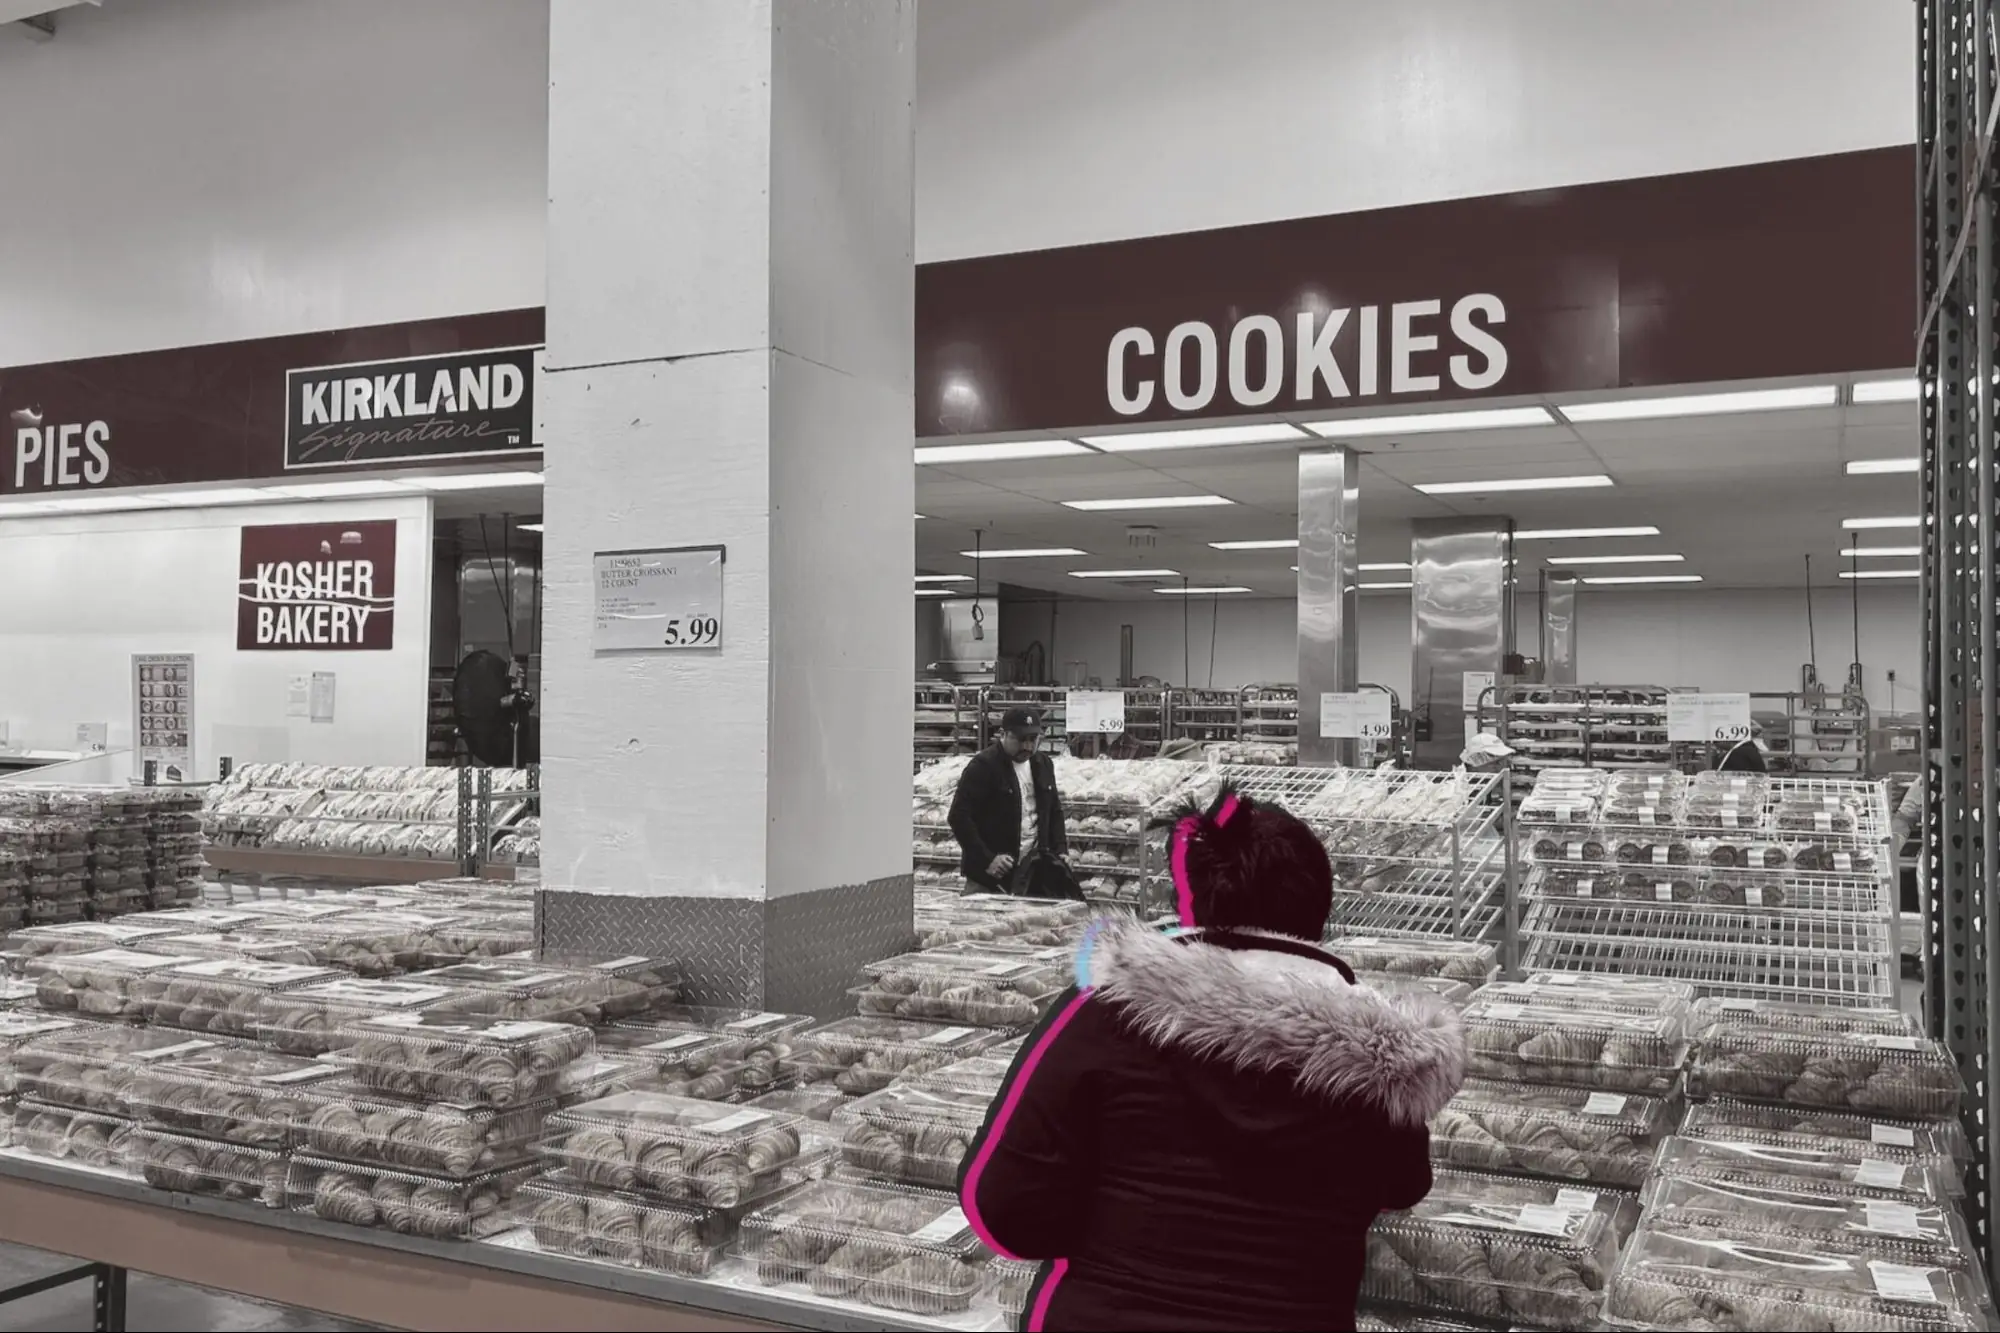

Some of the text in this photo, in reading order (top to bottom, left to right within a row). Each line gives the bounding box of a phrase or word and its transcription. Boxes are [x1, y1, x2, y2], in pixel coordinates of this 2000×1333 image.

[1106, 293, 1508, 415] COOKIES
[302, 363, 524, 425] KIRKLAND
[15, 420, 110, 488] PIES
[299, 416, 520, 462] Signature
[256, 560, 374, 600] KOSHER
[601, 567, 677, 579] BUTTER CROISSANT
[610, 578, 638, 588] COUNT
[256, 605, 371, 643] BAKERY
[664, 617, 718, 646] 5.99
[1099, 719, 1123, 731] 5.99
[1361, 723, 1390, 736] 4.99
[1715, 726, 1749, 739] 6.99
